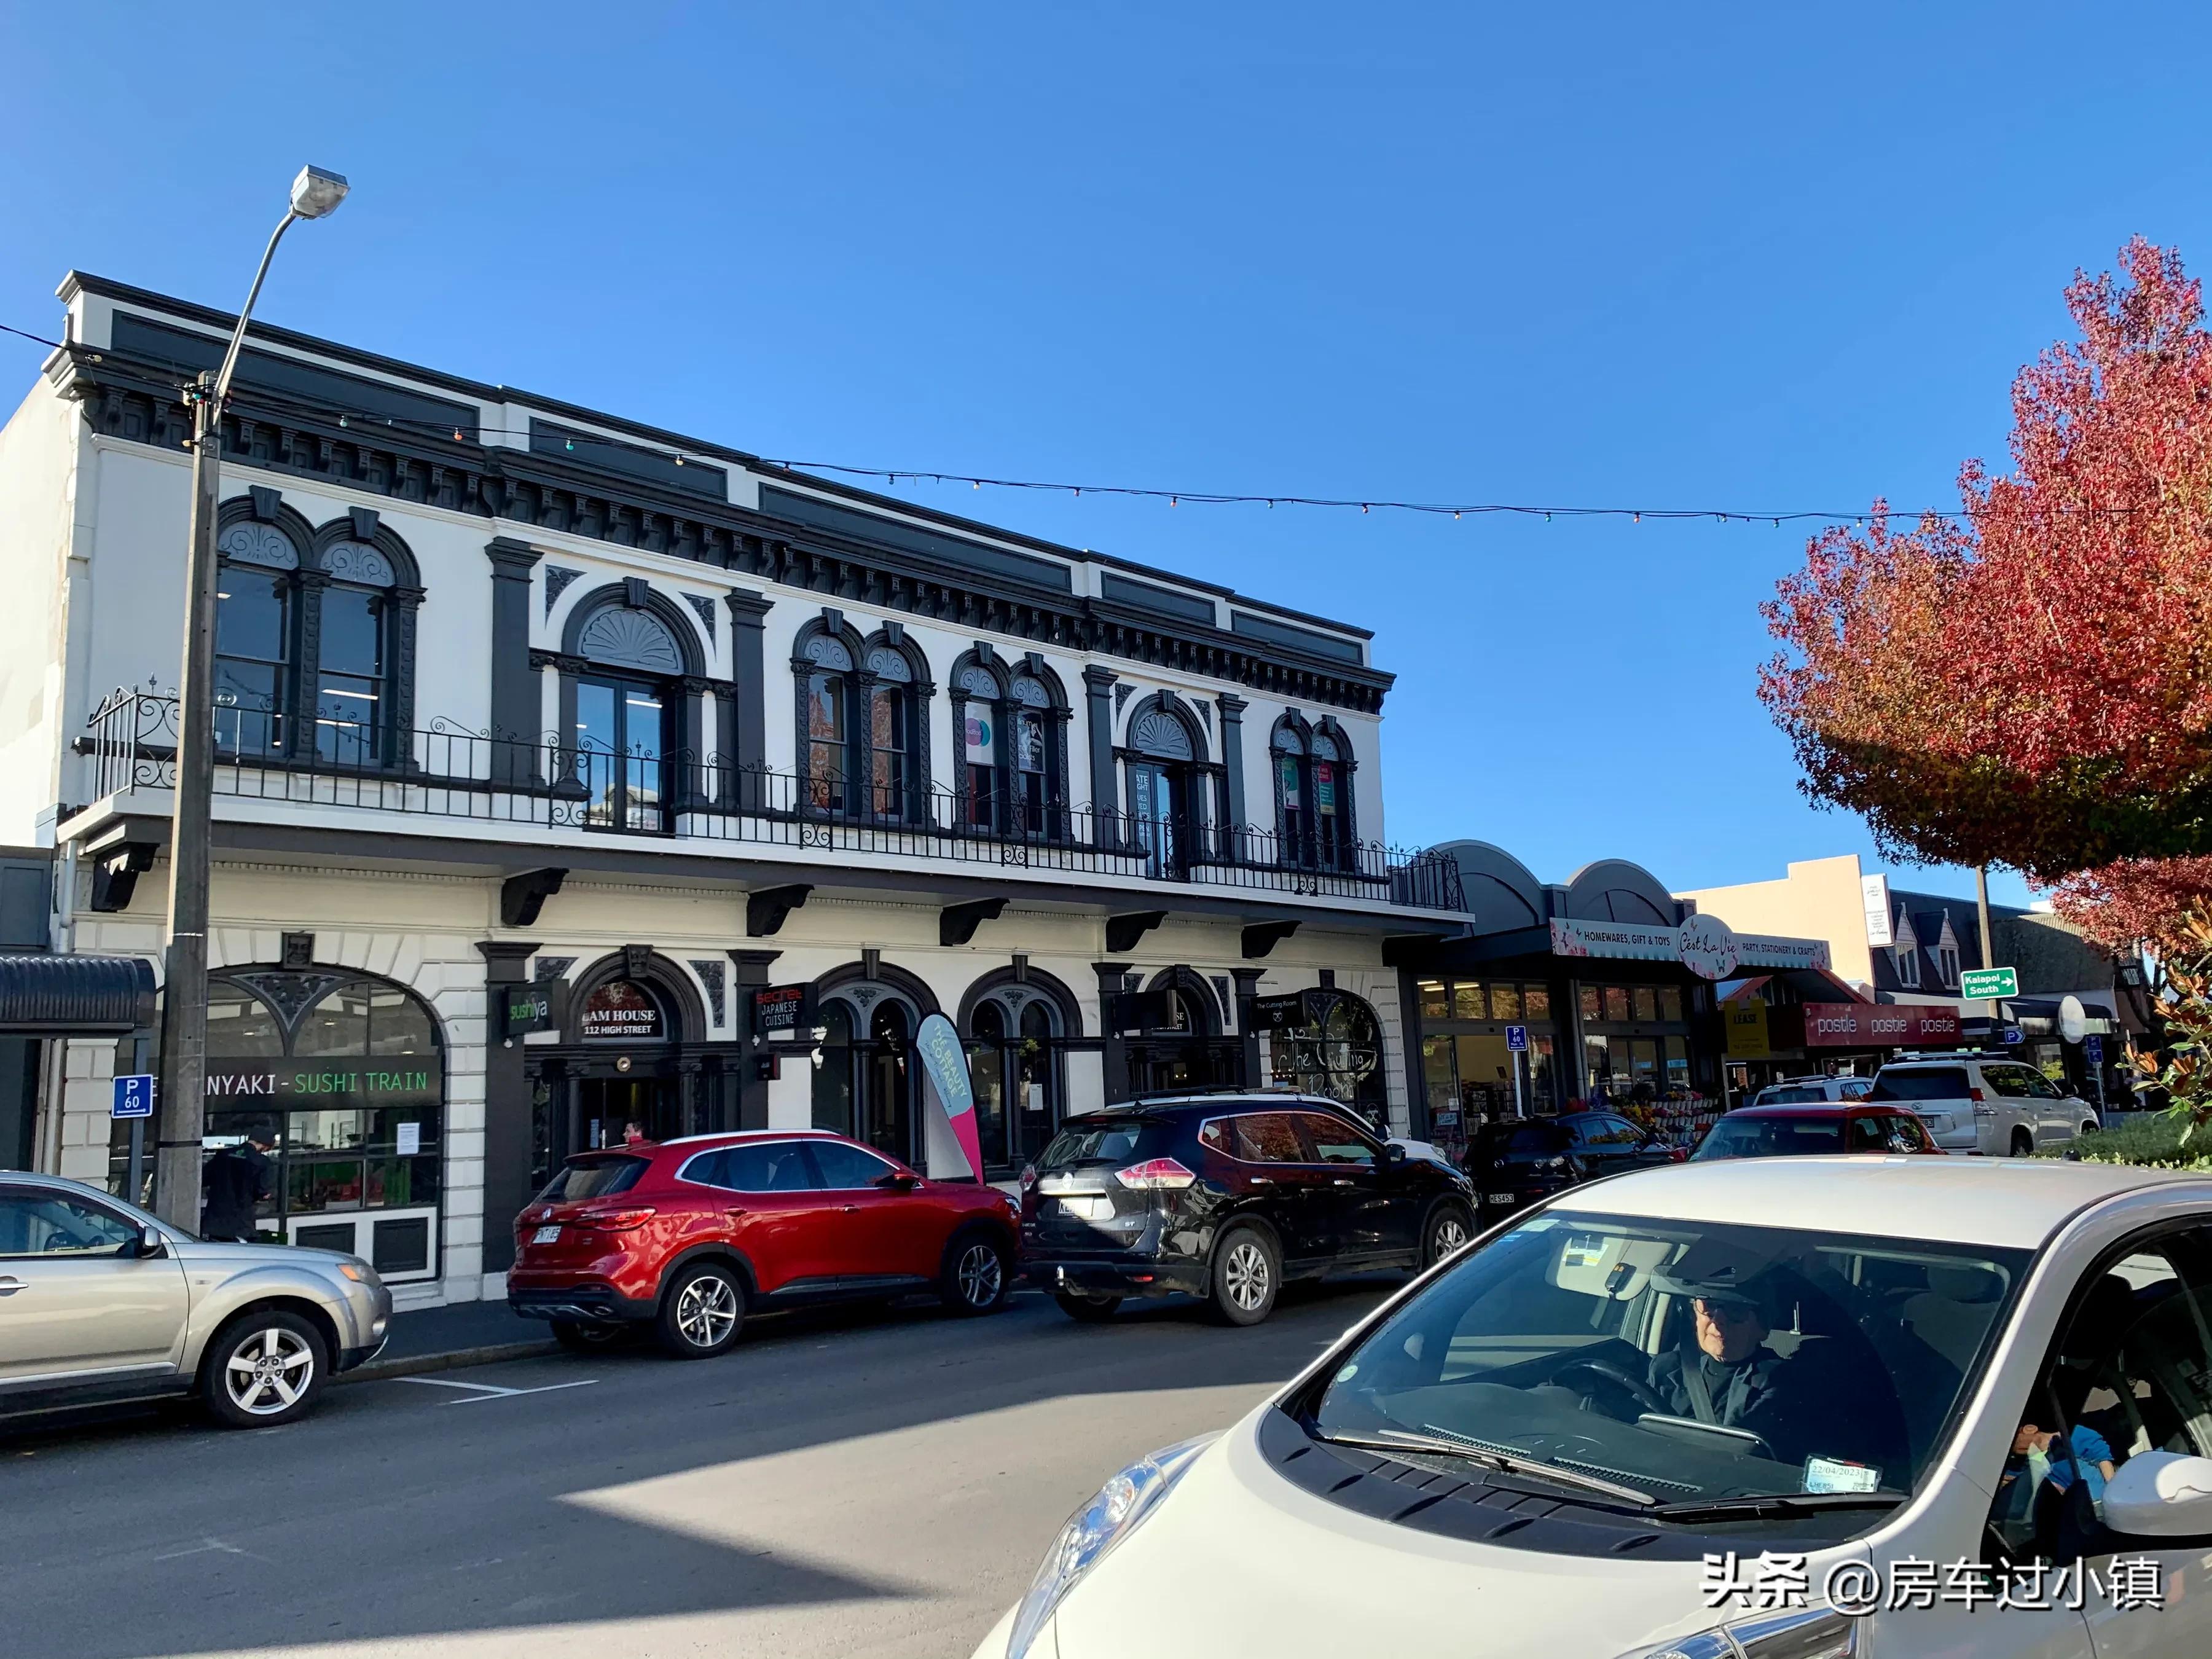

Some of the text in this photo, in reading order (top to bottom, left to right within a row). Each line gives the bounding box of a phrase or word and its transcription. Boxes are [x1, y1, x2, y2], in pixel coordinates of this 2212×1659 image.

[1584, 931, 1671, 946] HOMEWARES, GIFT & TOYS
[1743, 943, 1760, 954] PARTY,
[1761, 944, 1792, 955] STATIONERY
[1798, 947, 1816, 956] CRAFTS
[1965, 974, 2000, 984] Kaiapoi
[1970, 985, 1999, 995] South
[762, 1001, 797, 1015] JAPANESE
[613, 1010, 656, 1021] HOUSE
[766, 1013, 794, 1026] CUISINE
[584, 1025, 651, 1034] 112 HIGH STREET
[1818, 1014, 1955, 1036] postie postie postie
[931, 1040, 958, 1097] COTTAGE
[944, 1049, 968, 1097] BEAUTY
[127, 1080, 139, 1095] P
[203, 1074, 275, 1096] NYAKI
[294, 1073, 357, 1094] SUSHI
[365, 1072, 427, 1092] TRAIN
[125, 1096, 139, 1108] 60
[1490, 1194, 1514, 1202] HES453
[1812, 1465, 1860, 1476] 22/04/2023
